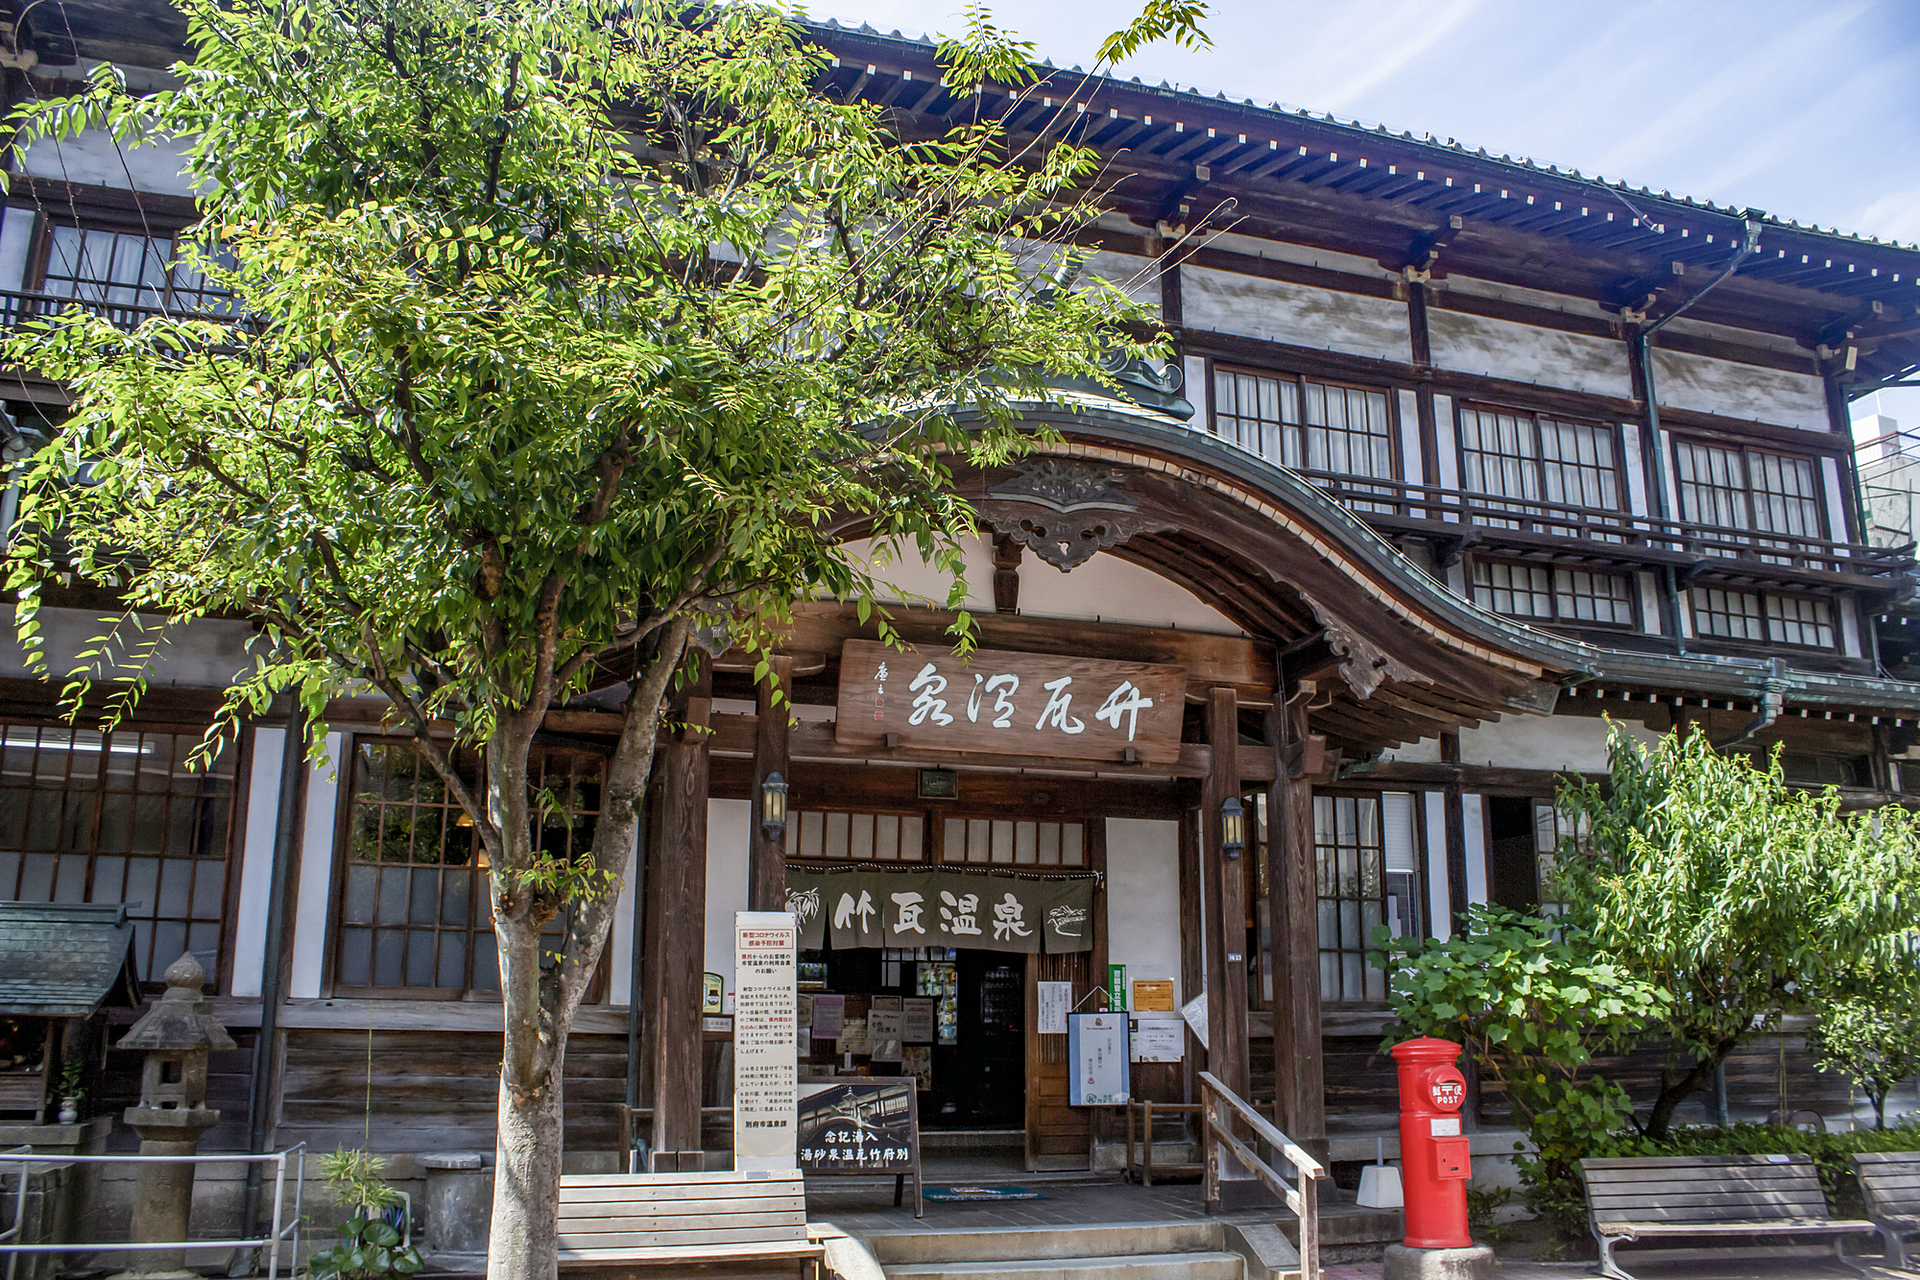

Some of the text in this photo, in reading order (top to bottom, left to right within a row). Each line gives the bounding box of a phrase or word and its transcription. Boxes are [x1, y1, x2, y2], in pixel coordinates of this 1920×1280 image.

[834, 889, 1033, 942] 竹瓦温泉
[1437, 1096, 1458, 1104] POST
[745, 1120, 787, 1128] 別府市温泉課
